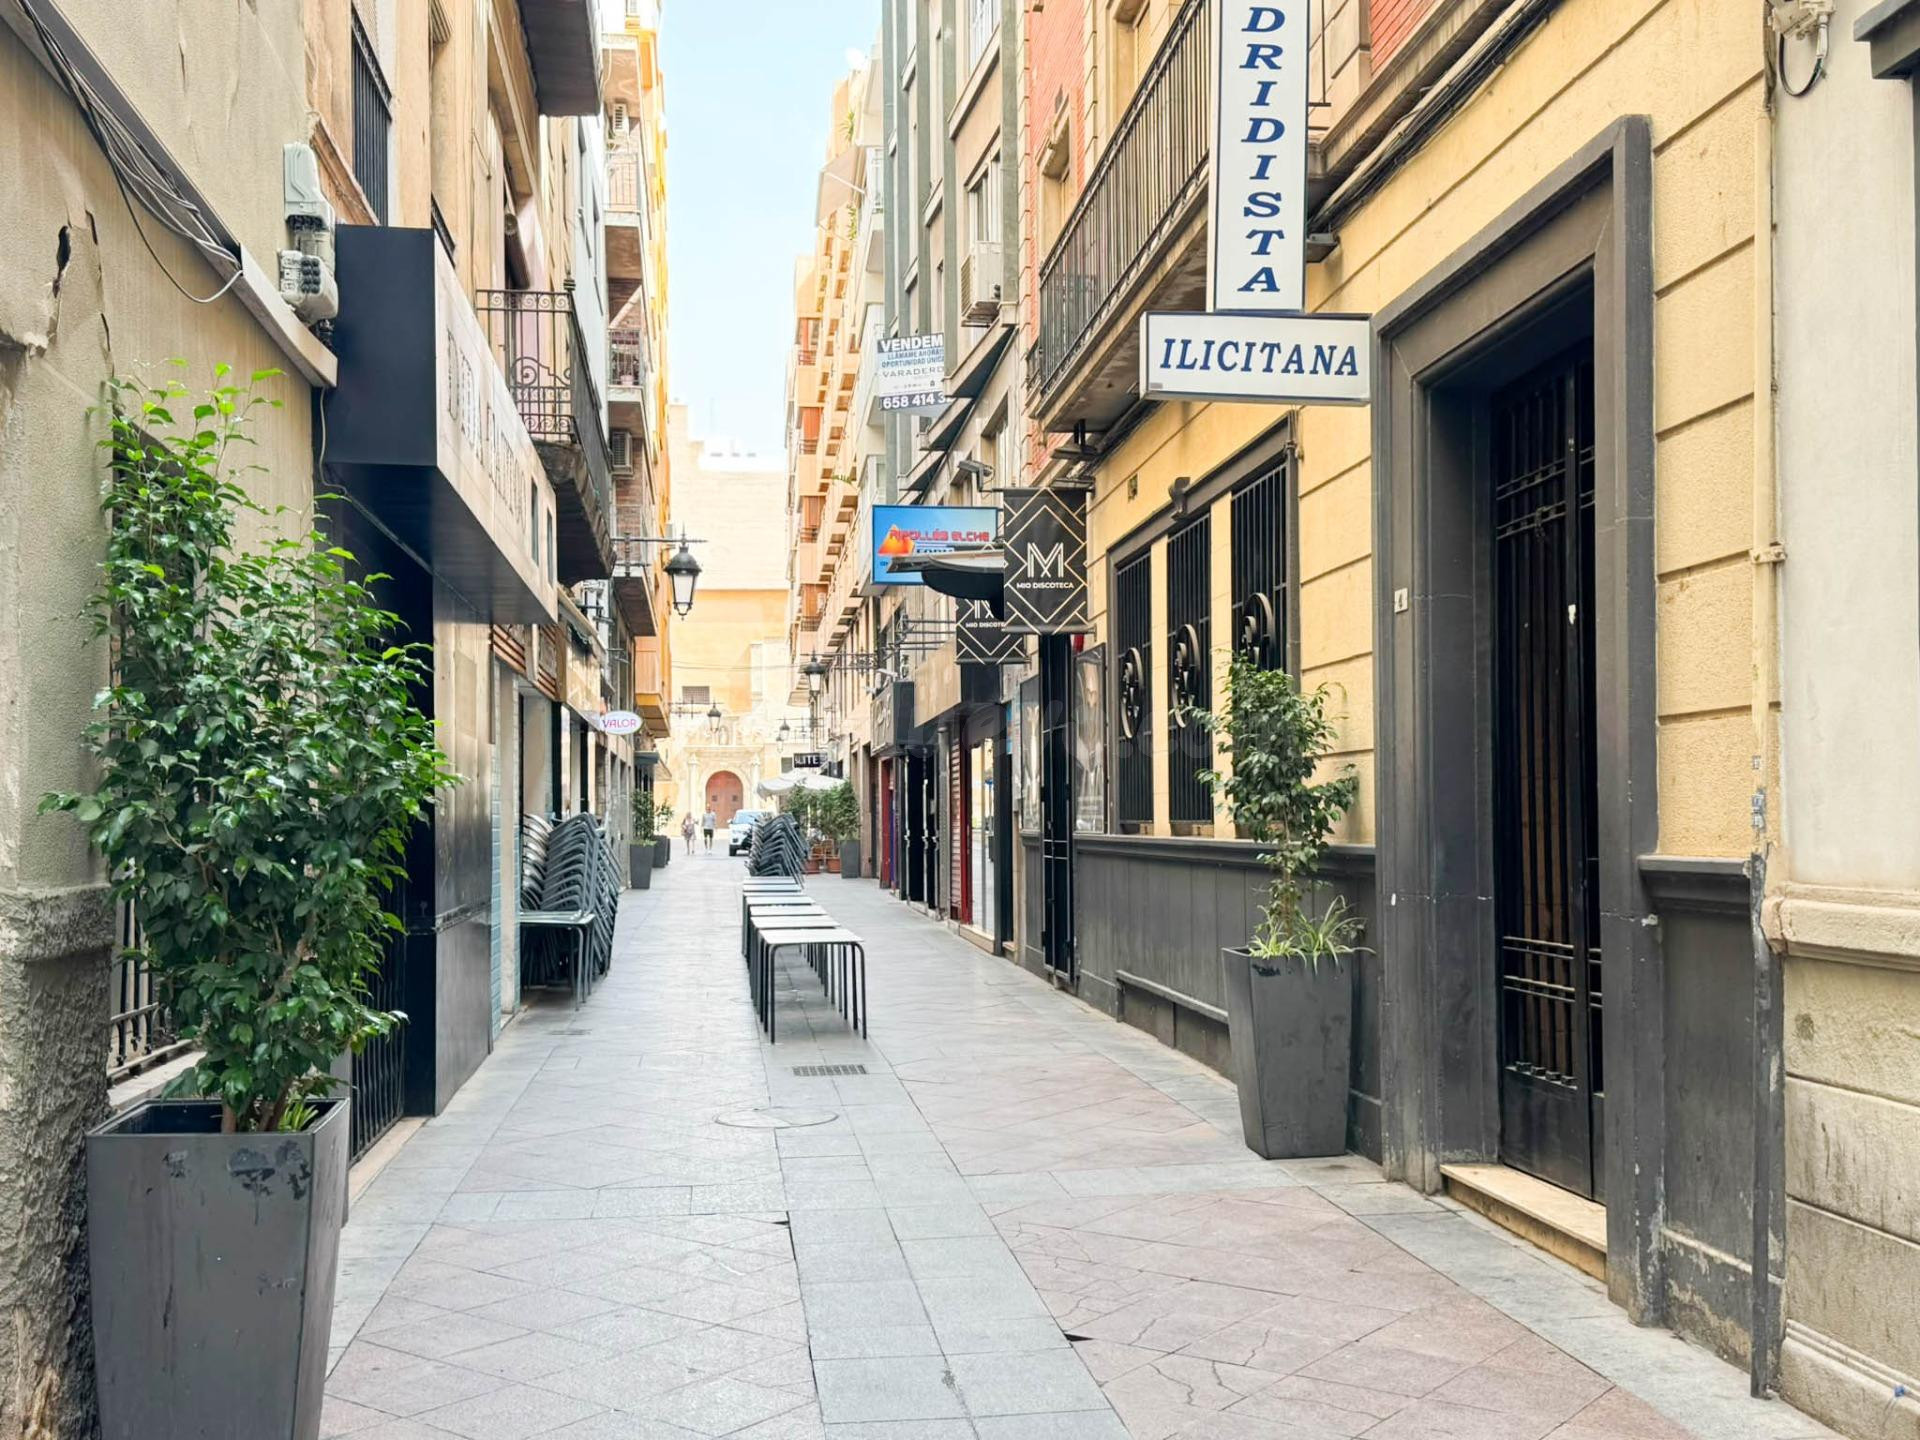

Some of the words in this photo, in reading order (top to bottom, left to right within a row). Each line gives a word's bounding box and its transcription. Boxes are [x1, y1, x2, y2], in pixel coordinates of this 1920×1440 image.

[1237, 6, 1286, 293] DRIDISTA
[880, 334, 944, 352] VENDEM
[1159, 338, 1359, 376] ILICITANA
[882, 396, 909, 410] 658
[912, 393, 935, 406] 414
[951, 530, 990, 542] ELCHE
[602, 719, 637, 728] VALOR
